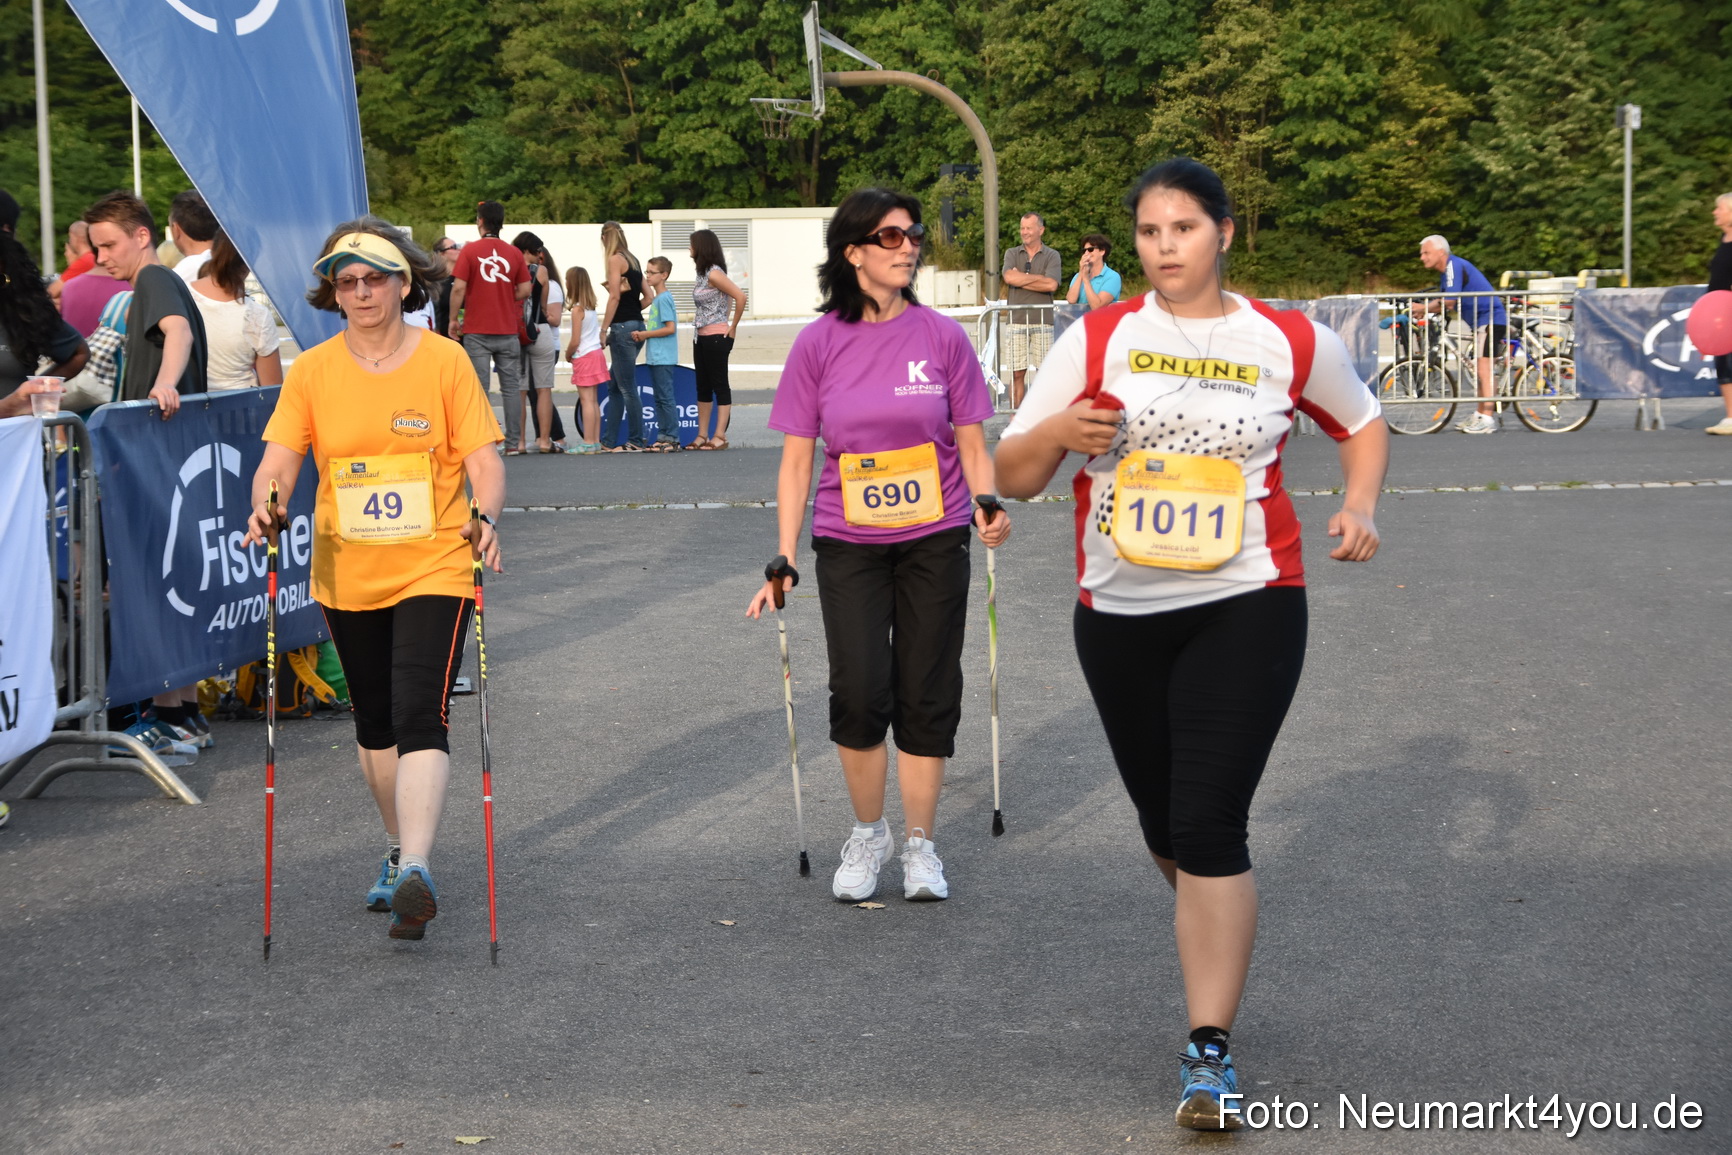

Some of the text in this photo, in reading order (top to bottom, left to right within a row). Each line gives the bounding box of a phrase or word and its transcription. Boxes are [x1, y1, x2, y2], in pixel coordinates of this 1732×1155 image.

[908, 360, 930, 383] K
[1135, 352, 1249, 380] ONLINE
[894, 384, 943, 392] KÜFNER
[1198, 379, 1256, 399] Germany
[345, 471, 380, 479] firmenlauf
[336, 481, 365, 490] walken
[863, 479, 921, 508] 690
[1122, 480, 1158, 491] walken
[363, 491, 403, 520] 49
[872, 511, 898, 519] Christine
[1128, 497, 1225, 539] 1011
[1150, 542, 1200, 553] Jessica Leibl
[267, 631, 275, 669] LEKI
